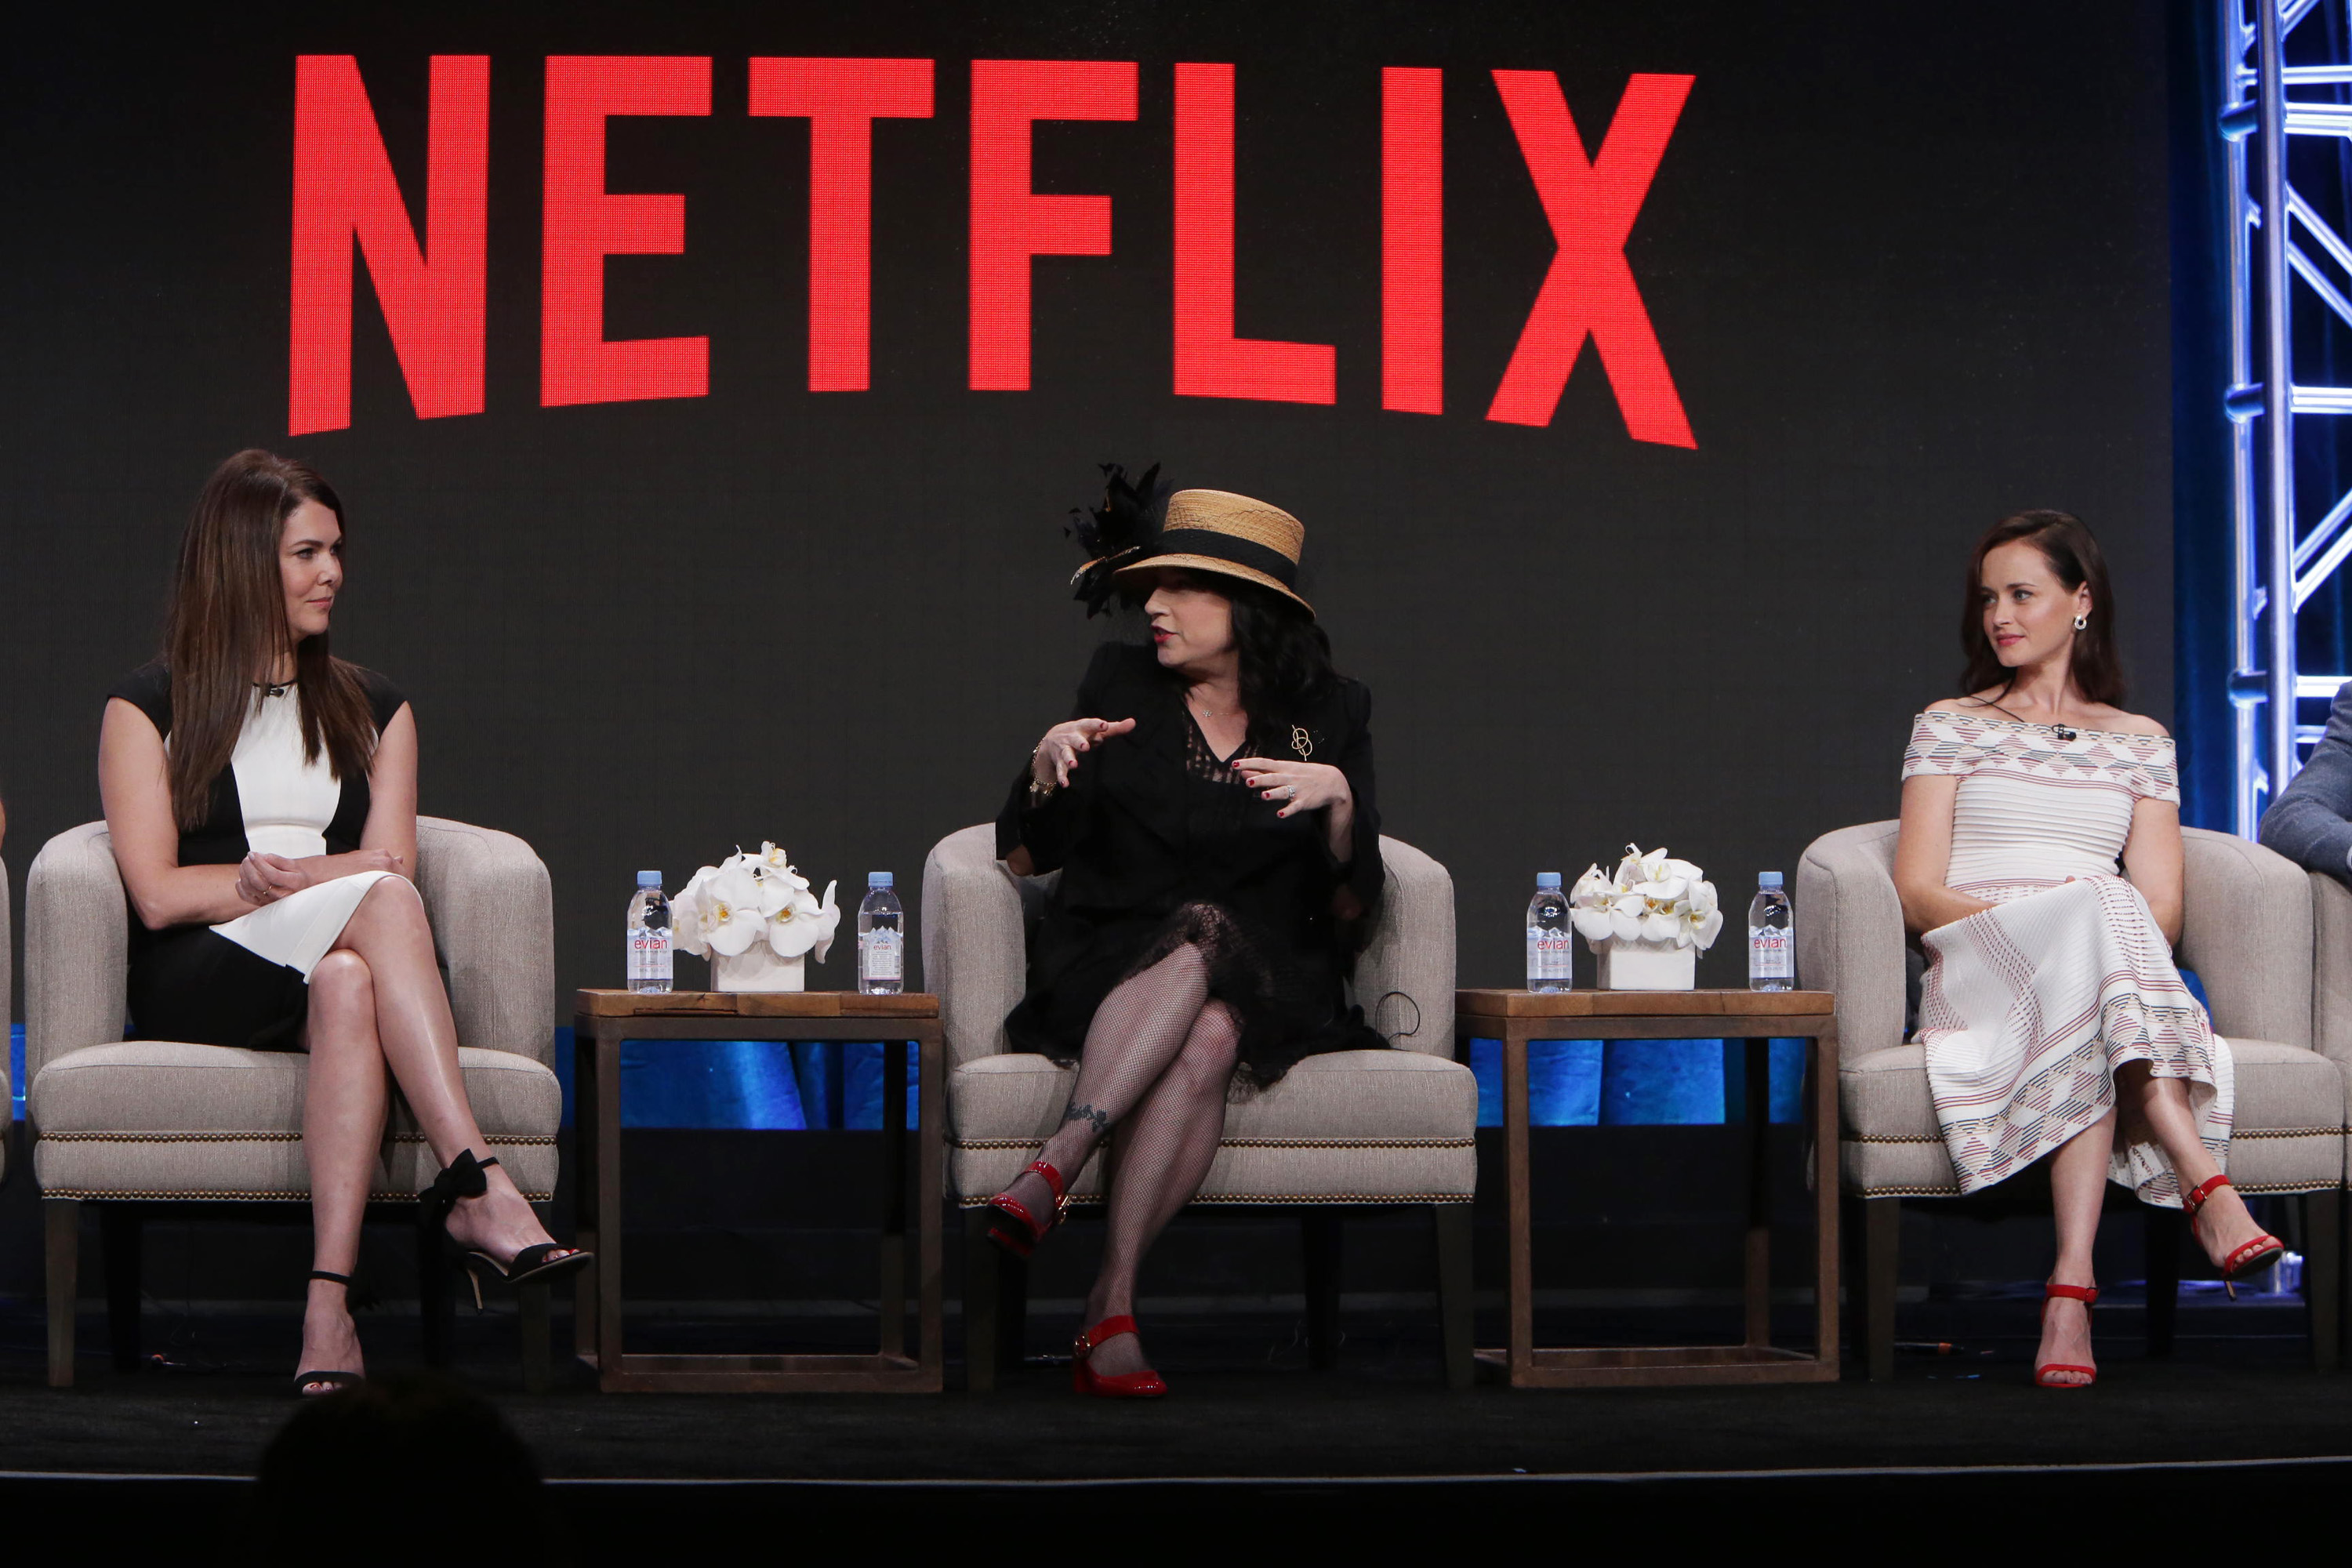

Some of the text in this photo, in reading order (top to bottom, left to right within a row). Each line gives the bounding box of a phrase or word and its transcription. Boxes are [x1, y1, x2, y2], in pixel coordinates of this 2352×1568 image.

[289, 55, 1698, 449] NETFLIX
[634, 937, 668, 949] evian
[1537, 938, 1570, 950] evian
[1754, 936, 1787, 949] evian
